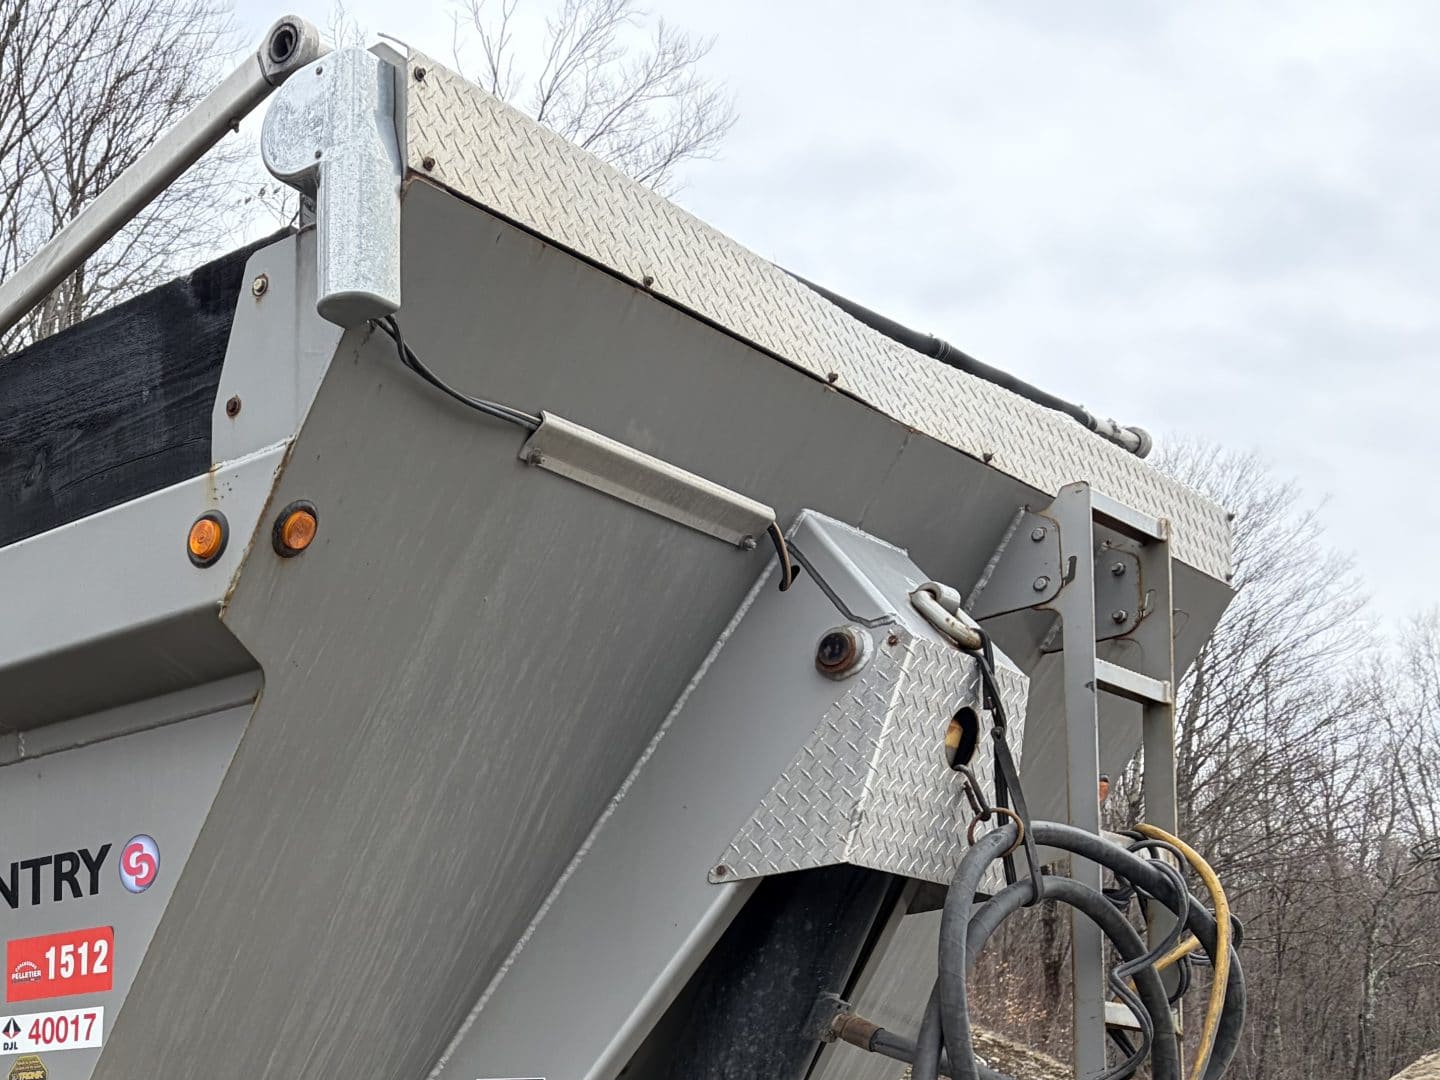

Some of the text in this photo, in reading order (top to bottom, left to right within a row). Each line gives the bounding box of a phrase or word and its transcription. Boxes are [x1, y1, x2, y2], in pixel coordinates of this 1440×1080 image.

[45, 939, 109, 980] 1512
[11, 969, 42, 980] PELLETIER
[28, 1013, 97, 1045] 40017
[3, 1041, 18, 1051] DJL
